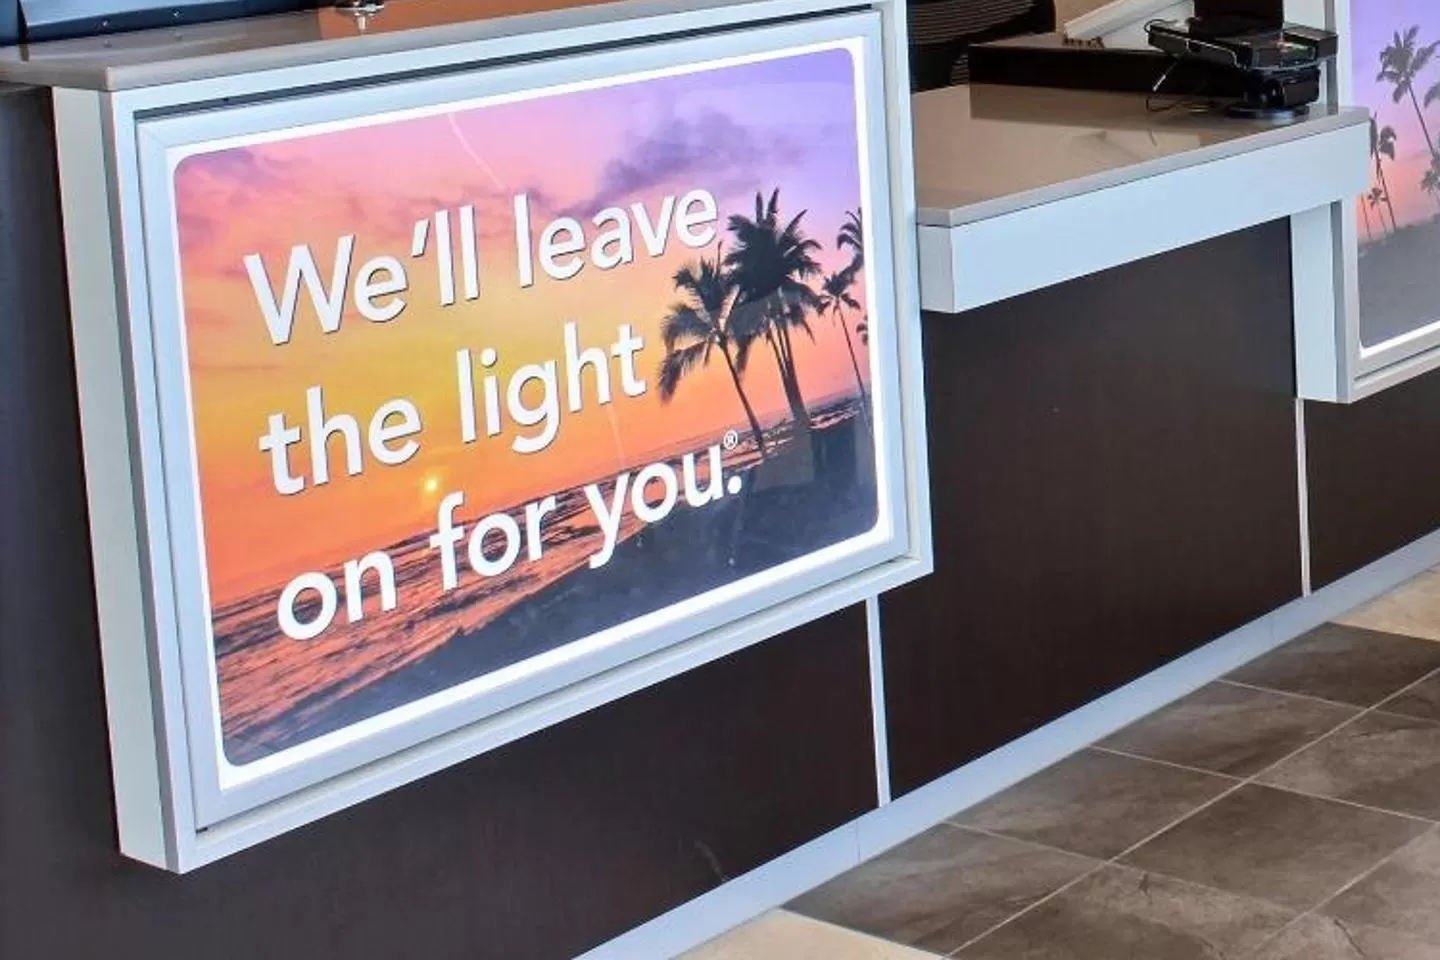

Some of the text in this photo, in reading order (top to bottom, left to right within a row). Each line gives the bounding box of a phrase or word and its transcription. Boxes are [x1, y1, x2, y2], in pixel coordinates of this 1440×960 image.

[245, 187, 719, 345] We'll leave
[260, 323, 648, 496] the light
[277, 548, 398, 640] on
[431, 490, 556, 593] for
